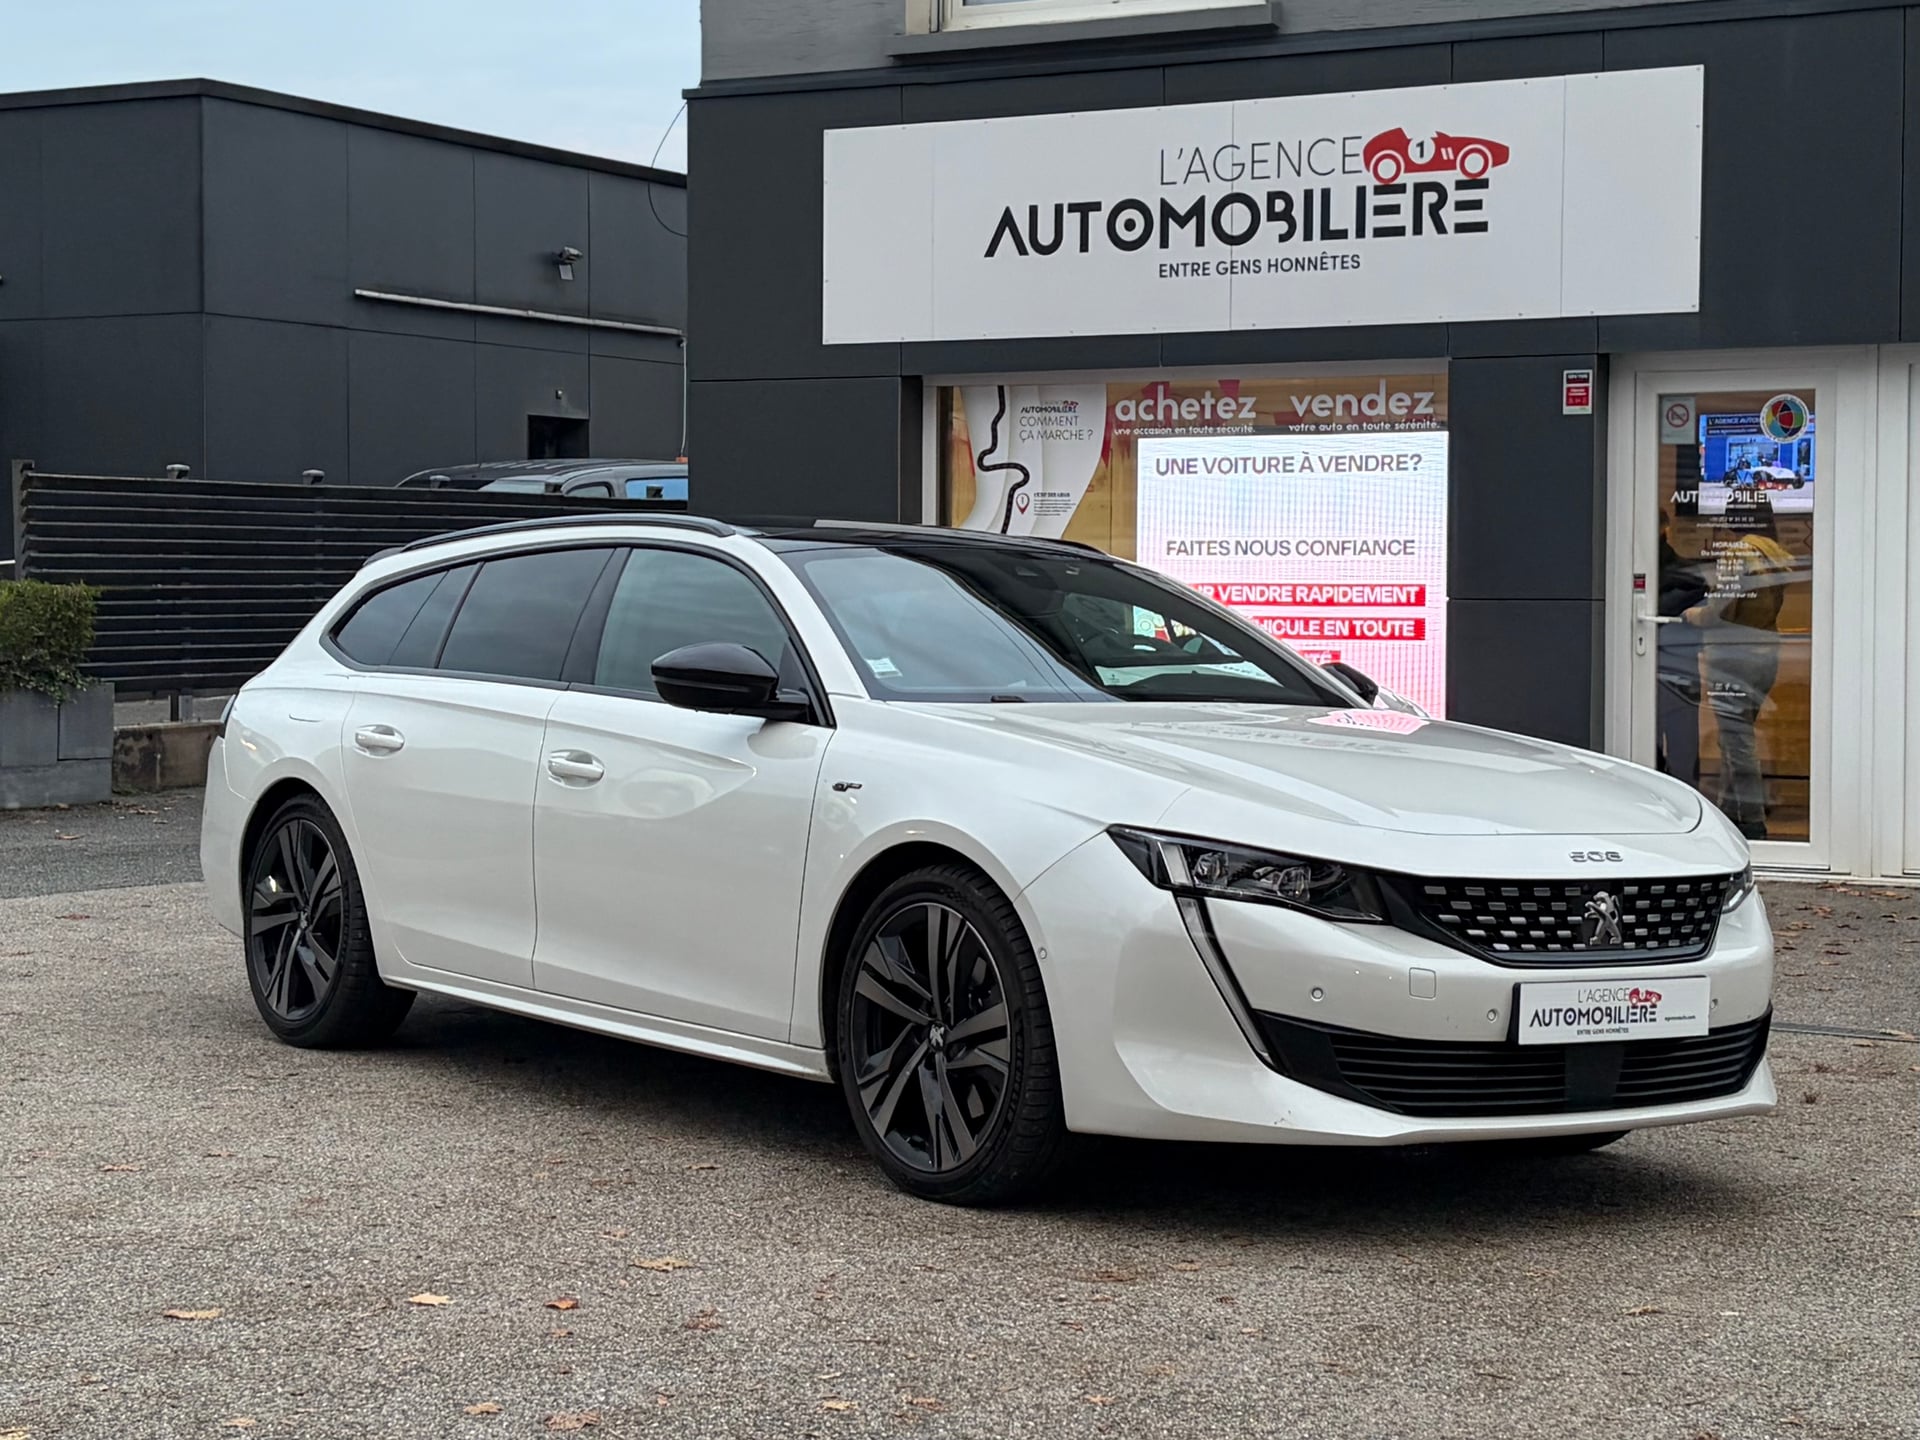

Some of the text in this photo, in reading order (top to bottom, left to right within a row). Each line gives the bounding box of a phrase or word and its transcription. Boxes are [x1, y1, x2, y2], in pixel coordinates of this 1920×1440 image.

[1160, 136, 1363, 185] L'AGENCE
[983, 177, 1490, 258] AUTOMOBILIERE
[1158, 252, 1361, 279] ENTRE GENS HONNÊTES
[1114, 384, 1257, 422] achetez
[1289, 378, 1435, 418] vendez
[1019, 415, 1080, 427] COMMENT
[1288, 423, 1316, 432] votre
[1318, 422, 1343, 432] auto
[1345, 423, 1360, 431] en
[1362, 420, 1392, 431] toute
[1019, 429, 1094, 443] ÇA MARCHE ?
[1113, 427, 1131, 436] une
[1133, 425, 1172, 435] occasion
[1188, 425, 1214, 434] toute
[1155, 450, 1423, 476] UNE VOITURE À VENDRE?
[1166, 539, 1416, 556] FAITES NOUS CONFIANCE
[1217, 586, 1295, 603] VENDRE
[1295, 585, 1420, 604] RAPIDEMENT
[1252, 619, 1415, 636] HICULE EN TOUTE
[1568, 851, 1624, 863] 508
[1577, 987, 1630, 1003] L'AGENCE
[1529, 1004, 1658, 1028] AUTOMOBILIERE
